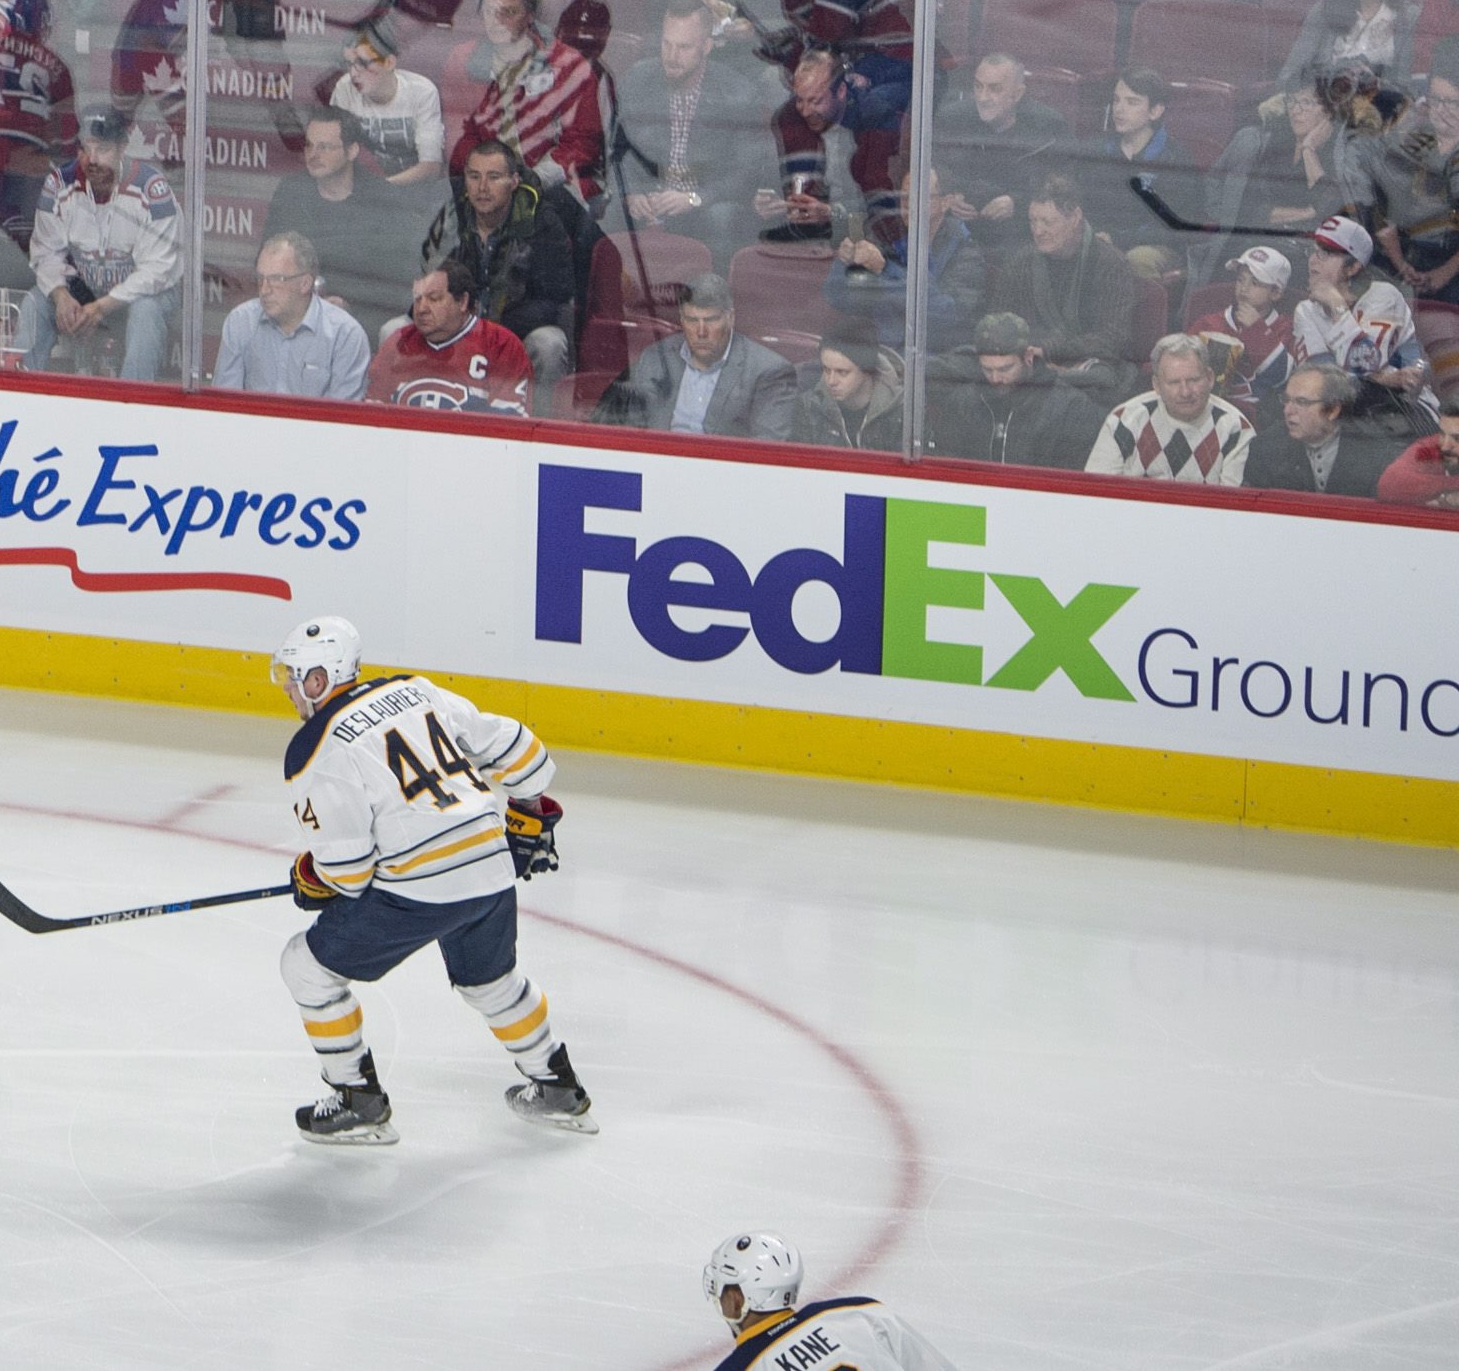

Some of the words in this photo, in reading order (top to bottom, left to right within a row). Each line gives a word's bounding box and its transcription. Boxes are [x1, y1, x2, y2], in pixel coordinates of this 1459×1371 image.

[206, 69, 293, 101] NADIAN
[154, 132, 267, 168] CAADIAN
[469, 354, 488, 379] C
[75, 442, 368, 557] Express
[534, 462, 1140, 703] FedEx
[382, 710, 492, 813] 44
[91, 905, 165, 927] NEXUS
[774, 1326, 841, 1371] KANE
